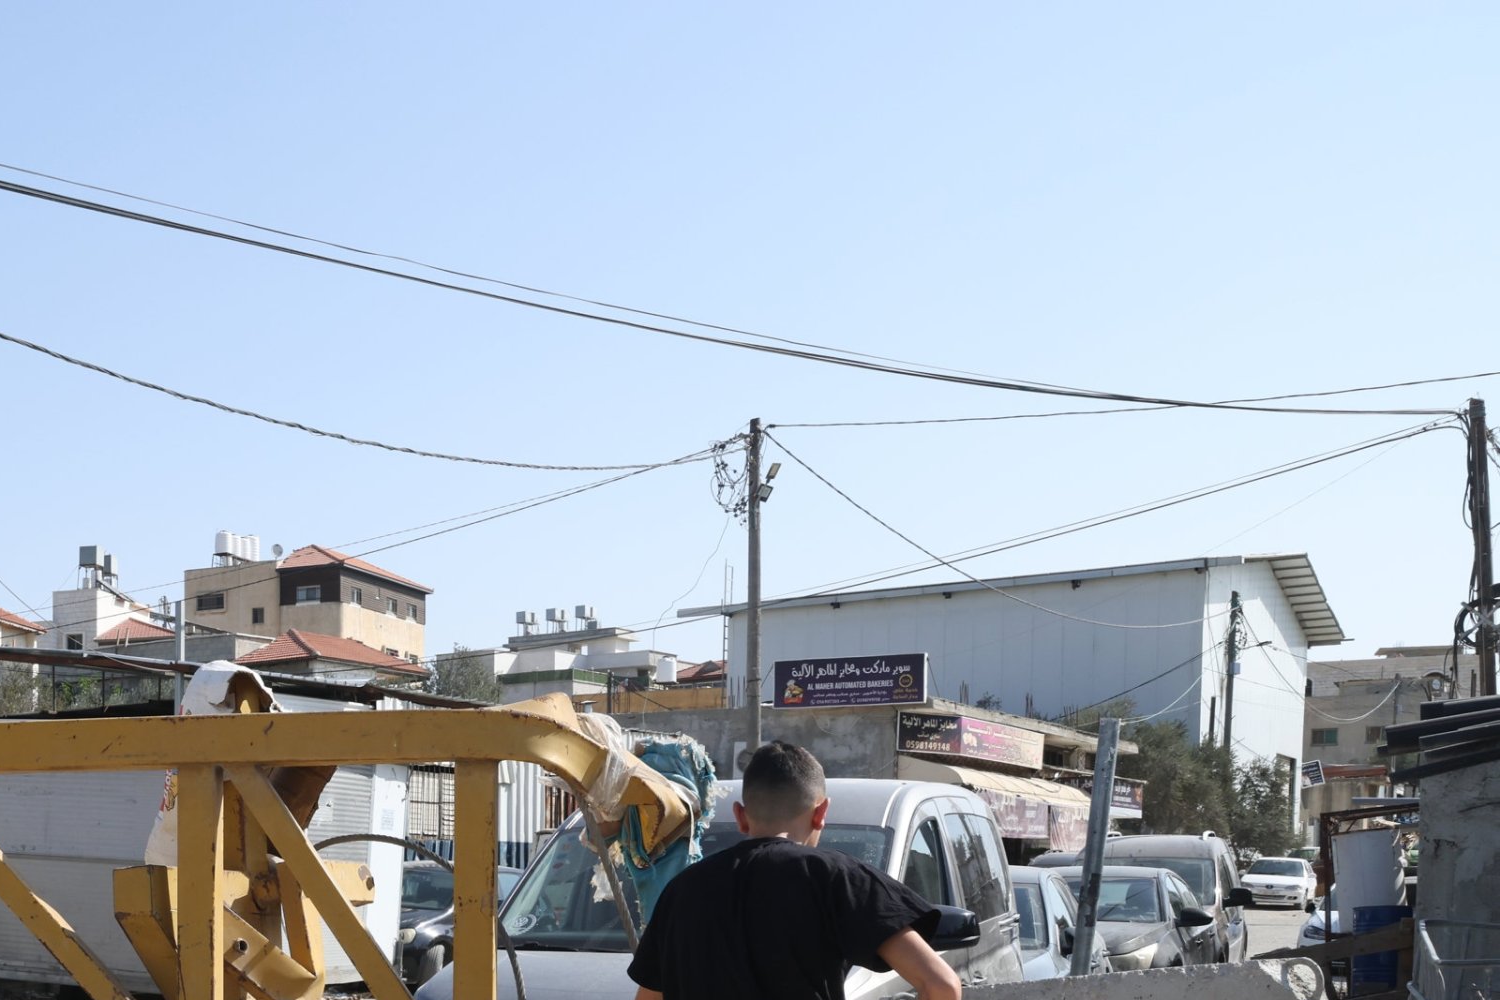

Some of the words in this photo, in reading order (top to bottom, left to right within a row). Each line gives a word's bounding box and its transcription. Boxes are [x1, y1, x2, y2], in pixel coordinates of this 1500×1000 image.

[815, 663, 837, 679] الماهر
[862, 660, 890, 674] ماركت
[815, 682, 834, 690] MAHER
[835, 680, 866, 689] AUTOMATED
[867, 679, 894, 687] BAKERIES
